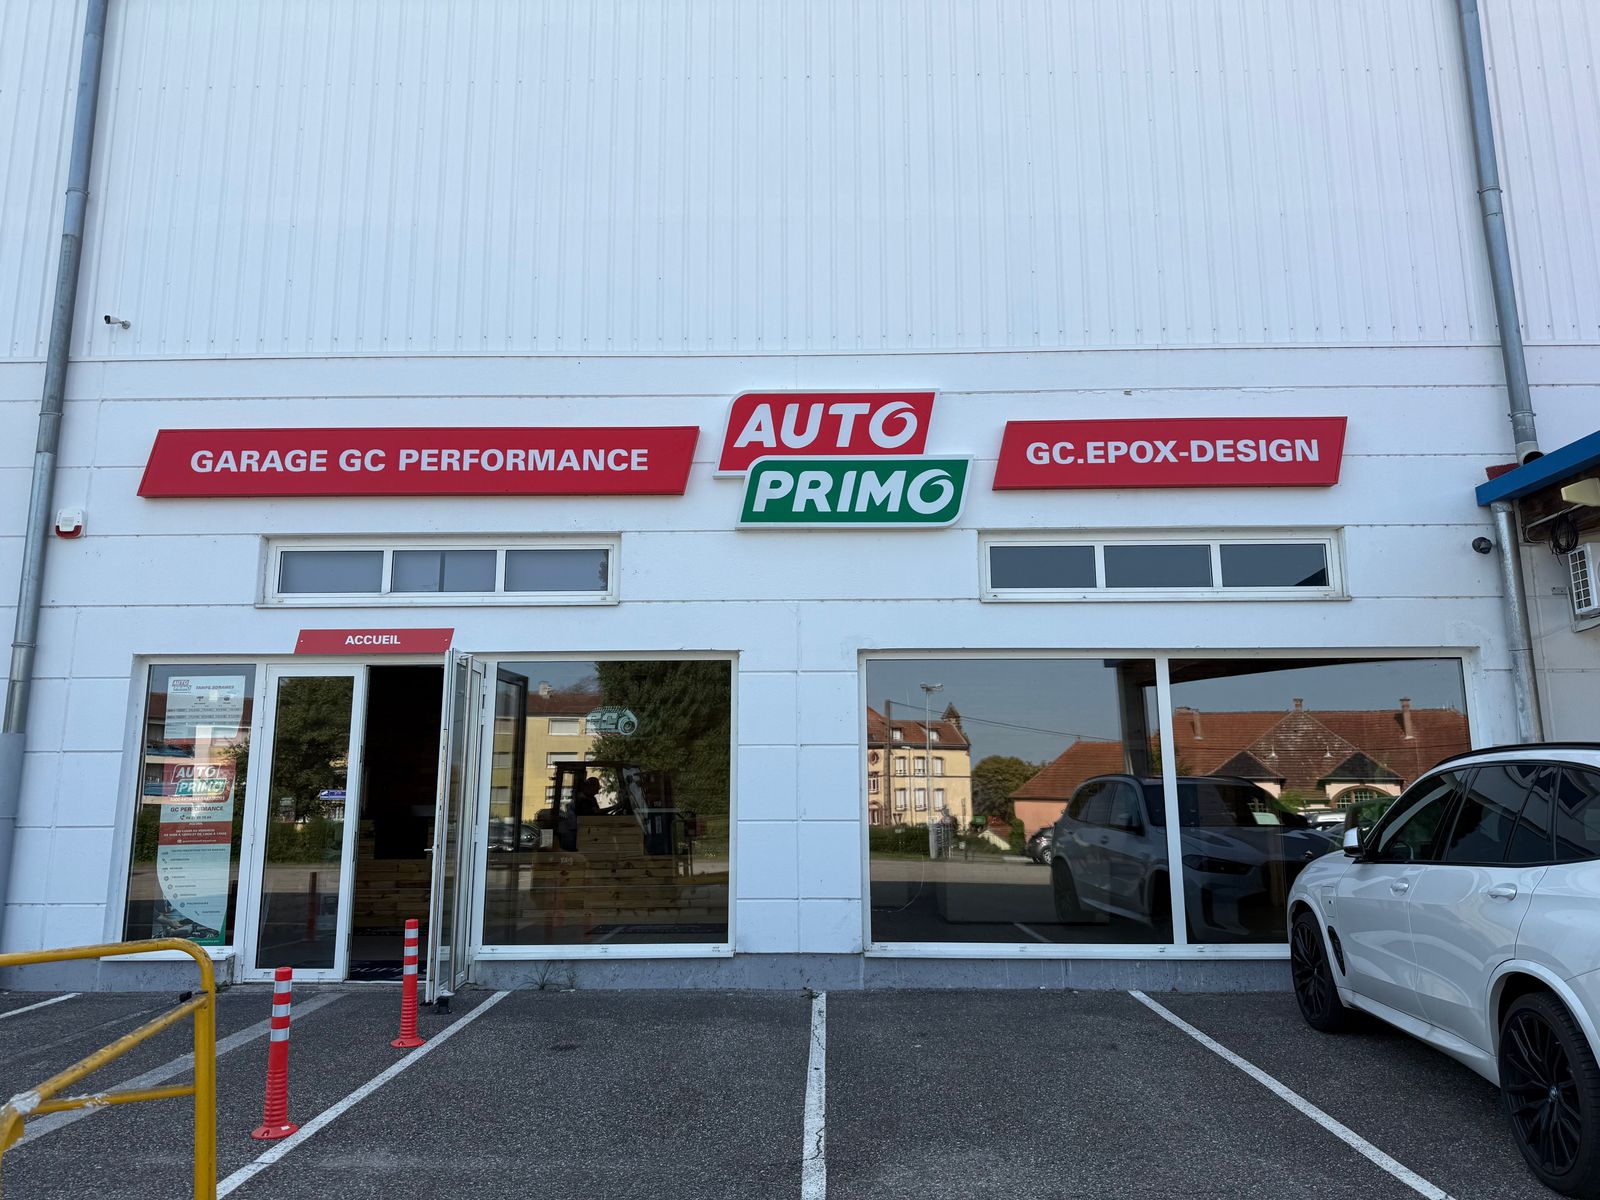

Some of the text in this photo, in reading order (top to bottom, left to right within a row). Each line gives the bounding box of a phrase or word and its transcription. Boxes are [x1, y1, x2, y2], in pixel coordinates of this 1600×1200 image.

[733, 400, 917, 448] AUTO
[191, 449, 648, 472] GARAGE GC PERFORMANCE
[1027, 439, 1319, 464] GC.EPOX-DESIGN
[751, 467, 954, 514] PRIMO
[345, 635, 400, 644] ACCUEIL
[175, 766, 217, 779] AUTO
[178, 781, 224, 793] PRIMO
